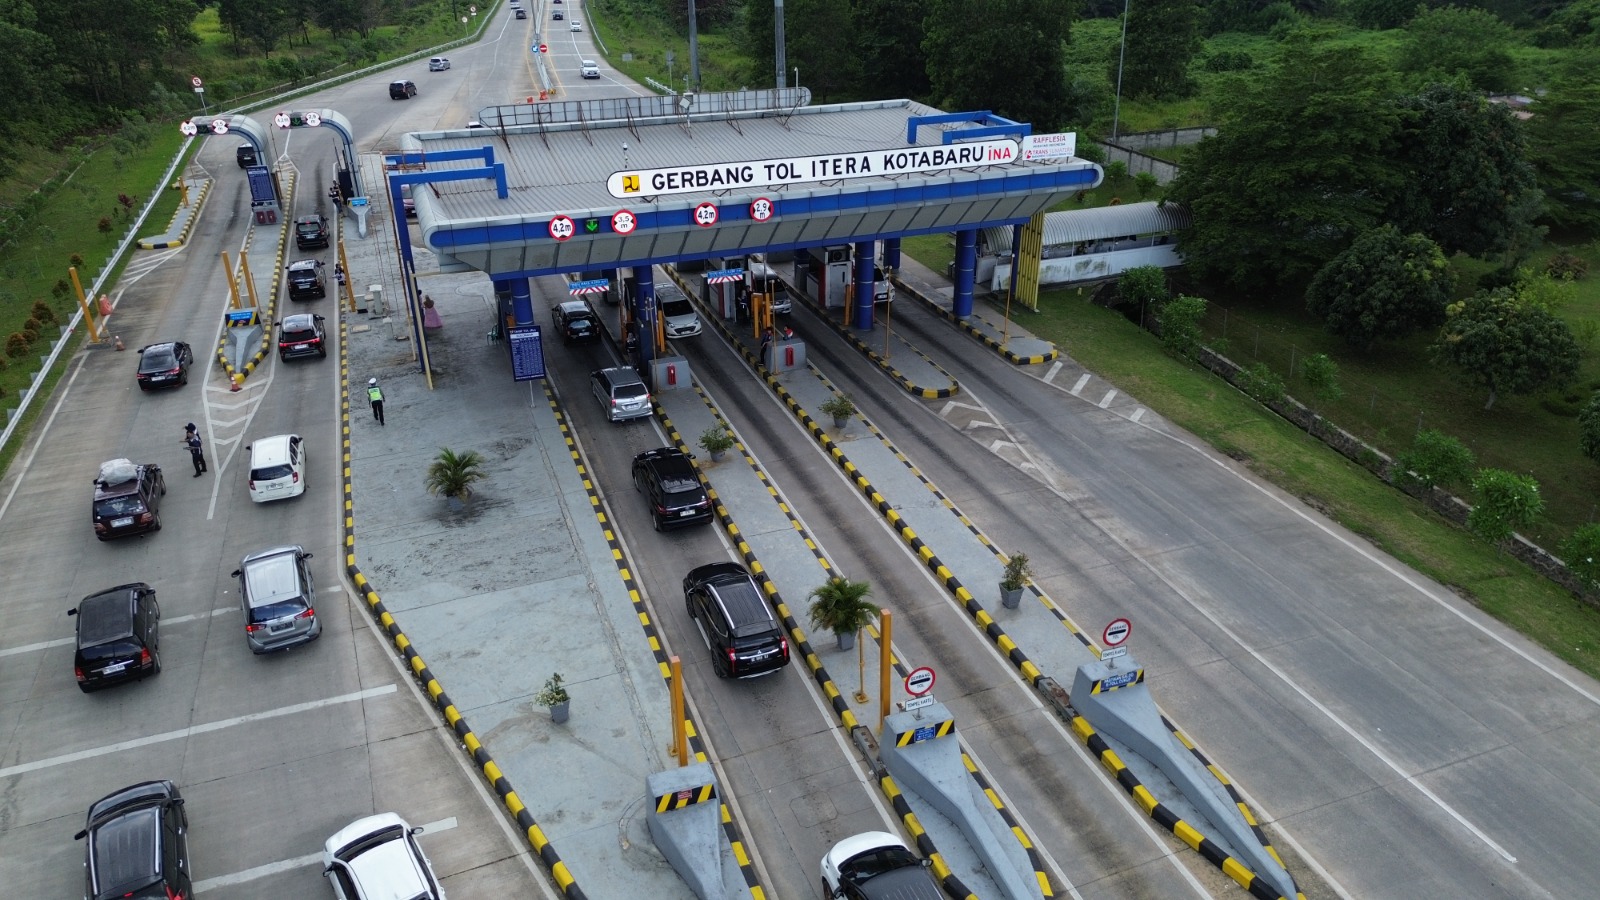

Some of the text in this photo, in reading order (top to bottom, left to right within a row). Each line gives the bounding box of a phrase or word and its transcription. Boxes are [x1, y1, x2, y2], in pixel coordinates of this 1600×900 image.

[1032, 135, 1066, 144] RAFFLESIA
[652, 166, 753, 190] GERBANG
[764, 162, 802, 181] TOL
[811, 155, 871, 177] ITERA
[883, 145, 984, 171] KOTABARU
[552, 222, 572, 233] 4,2m
[911, 673, 930, 681] GERBANG
